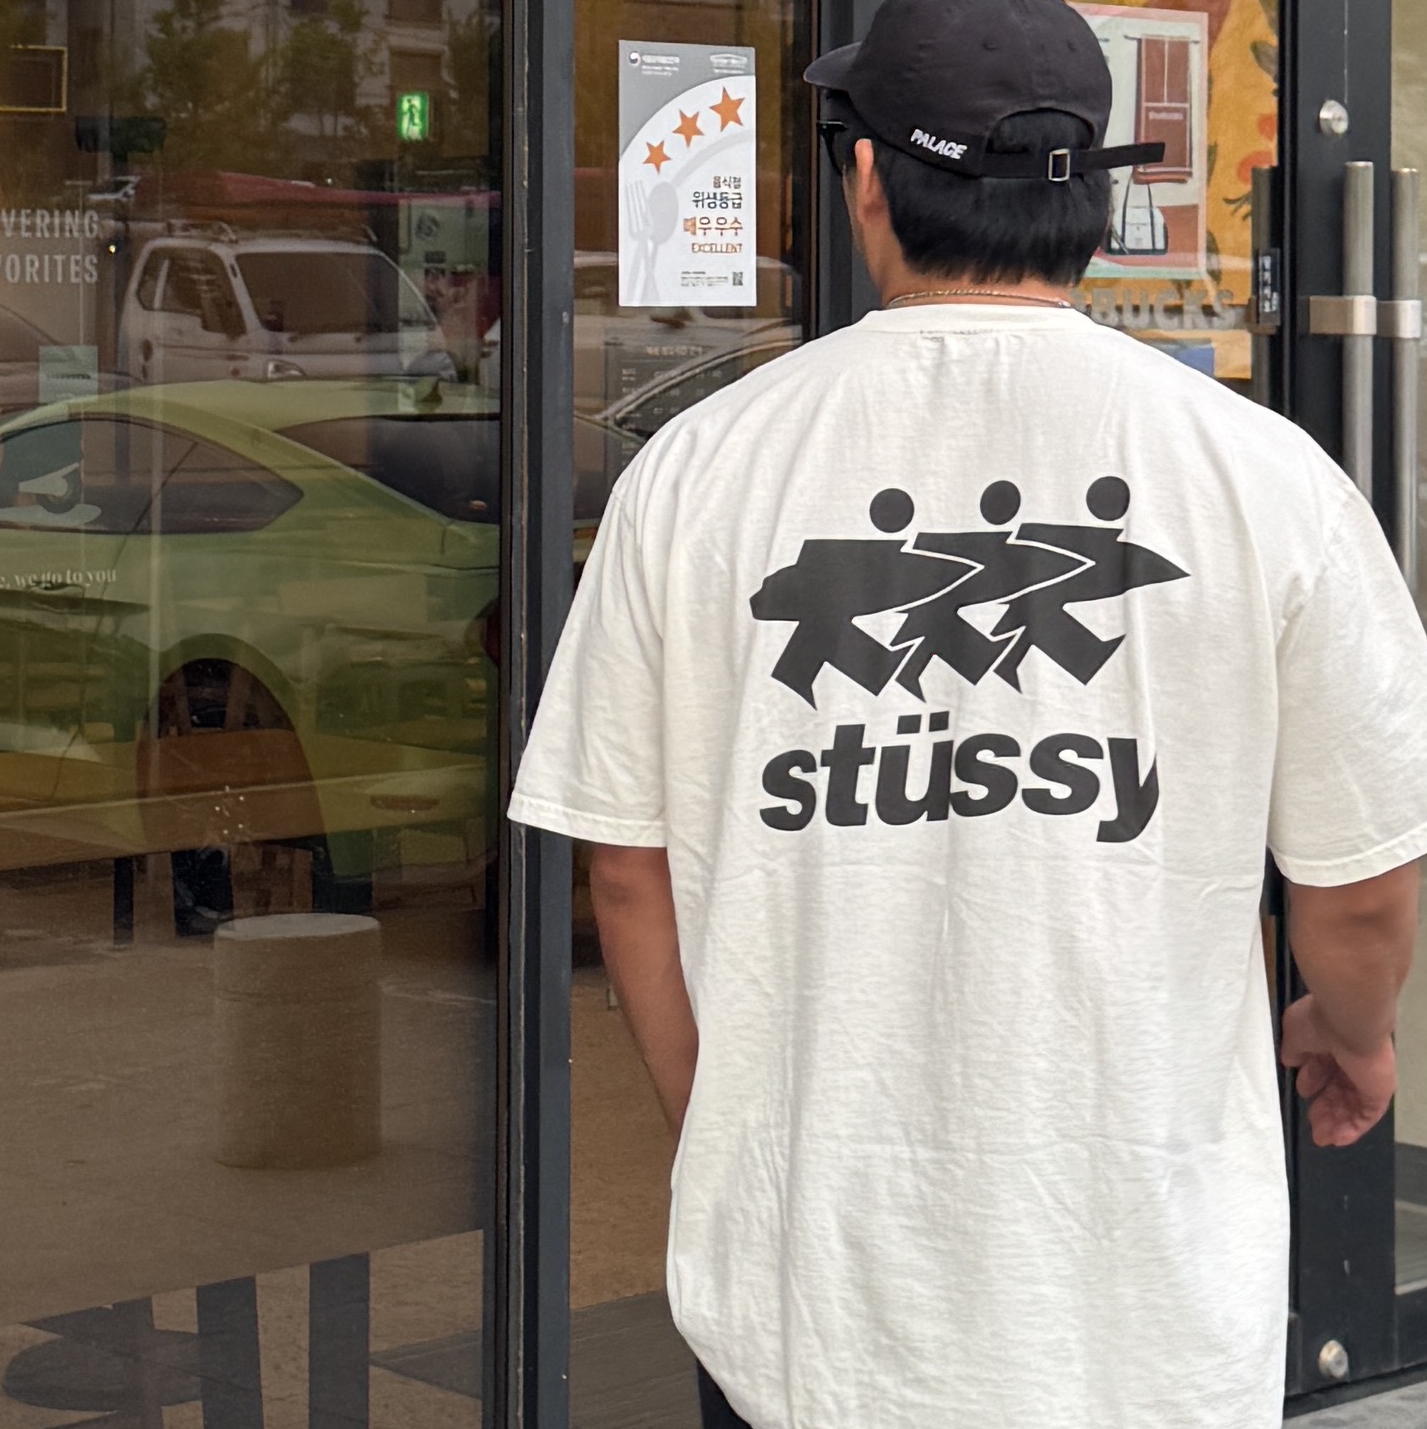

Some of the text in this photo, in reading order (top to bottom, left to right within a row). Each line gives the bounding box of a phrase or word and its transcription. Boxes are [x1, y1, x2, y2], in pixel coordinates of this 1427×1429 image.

[910, 128, 968, 160] PALACE
[692, 191, 743, 209] 위생등급
[759, 710, 1160, 844] stüssy
